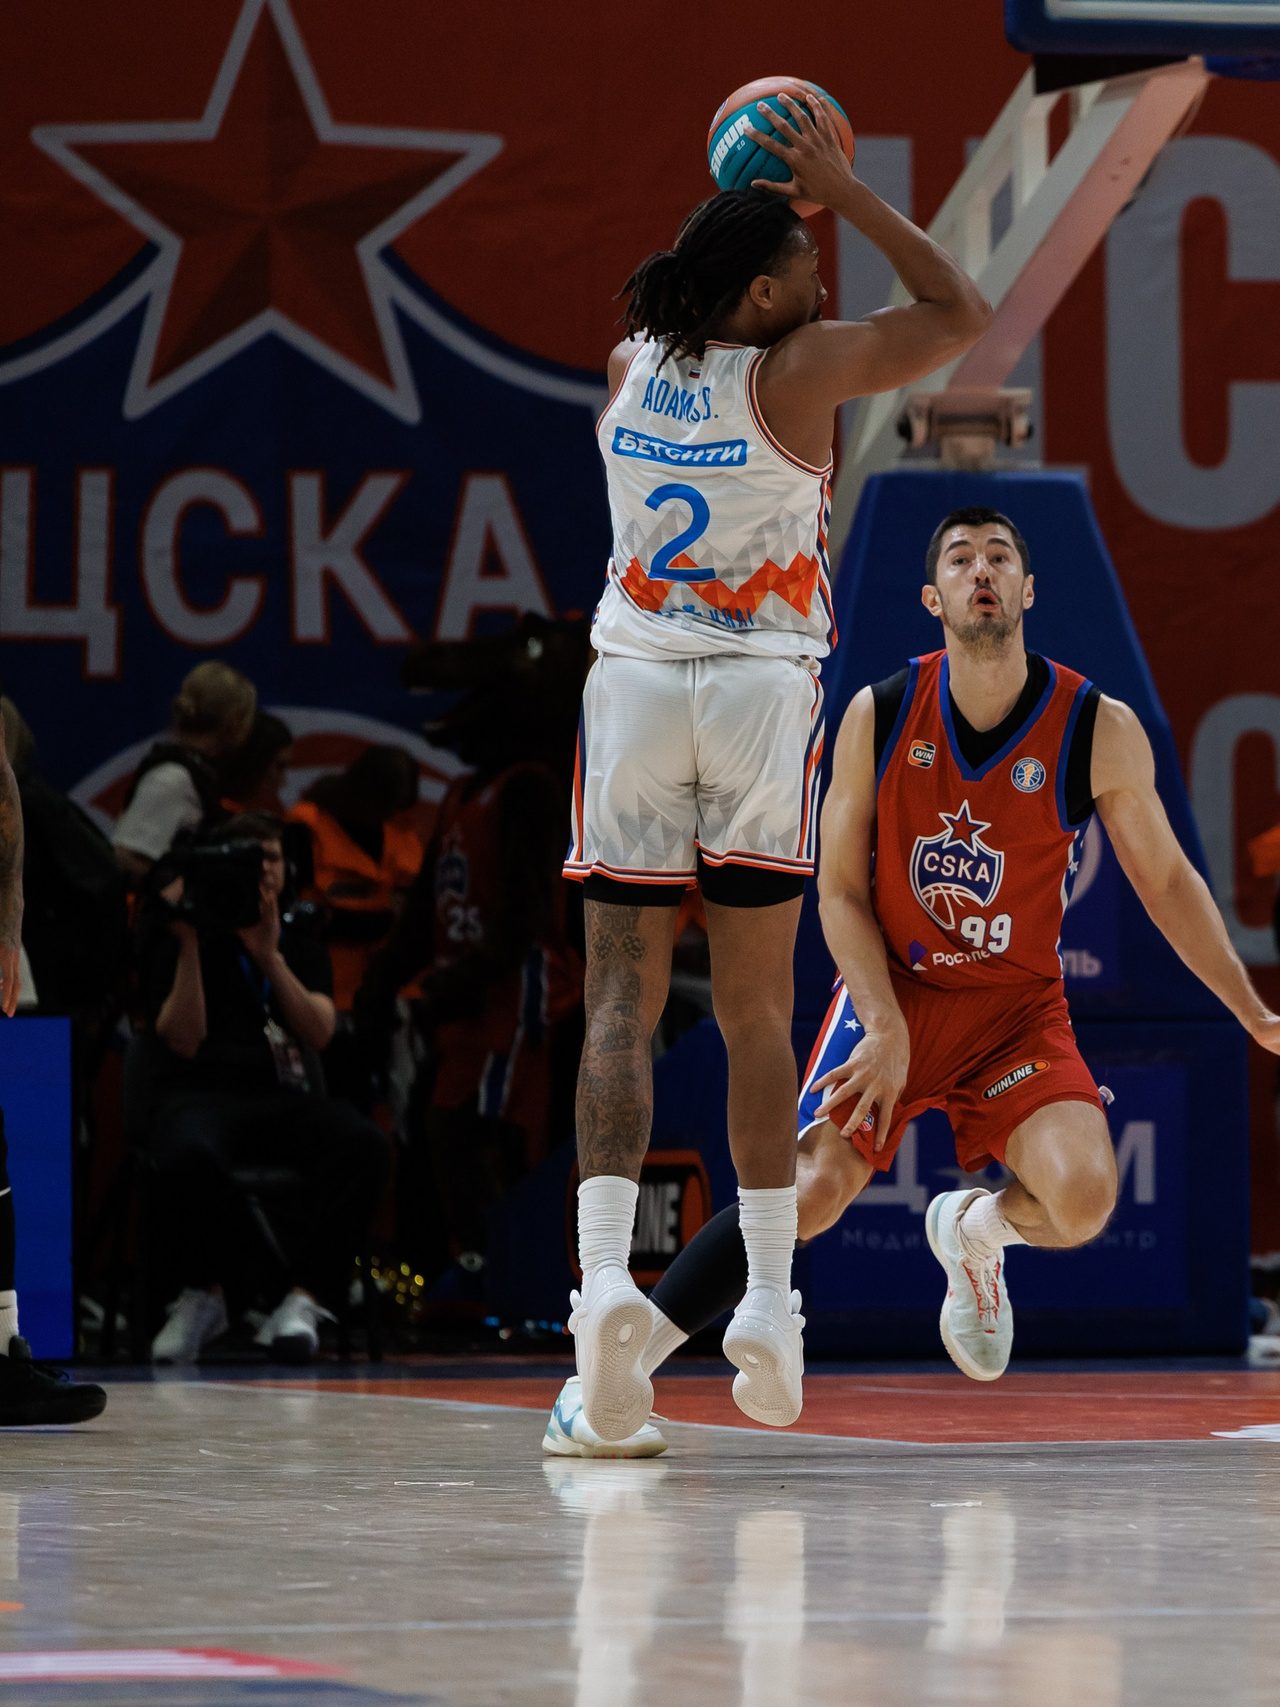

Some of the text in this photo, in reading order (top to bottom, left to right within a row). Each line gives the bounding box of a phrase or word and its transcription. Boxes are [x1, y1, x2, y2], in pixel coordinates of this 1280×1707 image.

[711, 113, 753, 179] SIBUR
[618, 432, 743, 463] БЕТСИТИ
[645, 483, 716, 582] 2
[0, 466, 557, 680] ЦСКА
[915, 749, 933, 761] WIN
[922, 851, 991, 884] CSKA
[959, 912, 1013, 955] 99
[987, 1064, 1034, 1098] WINLINE
